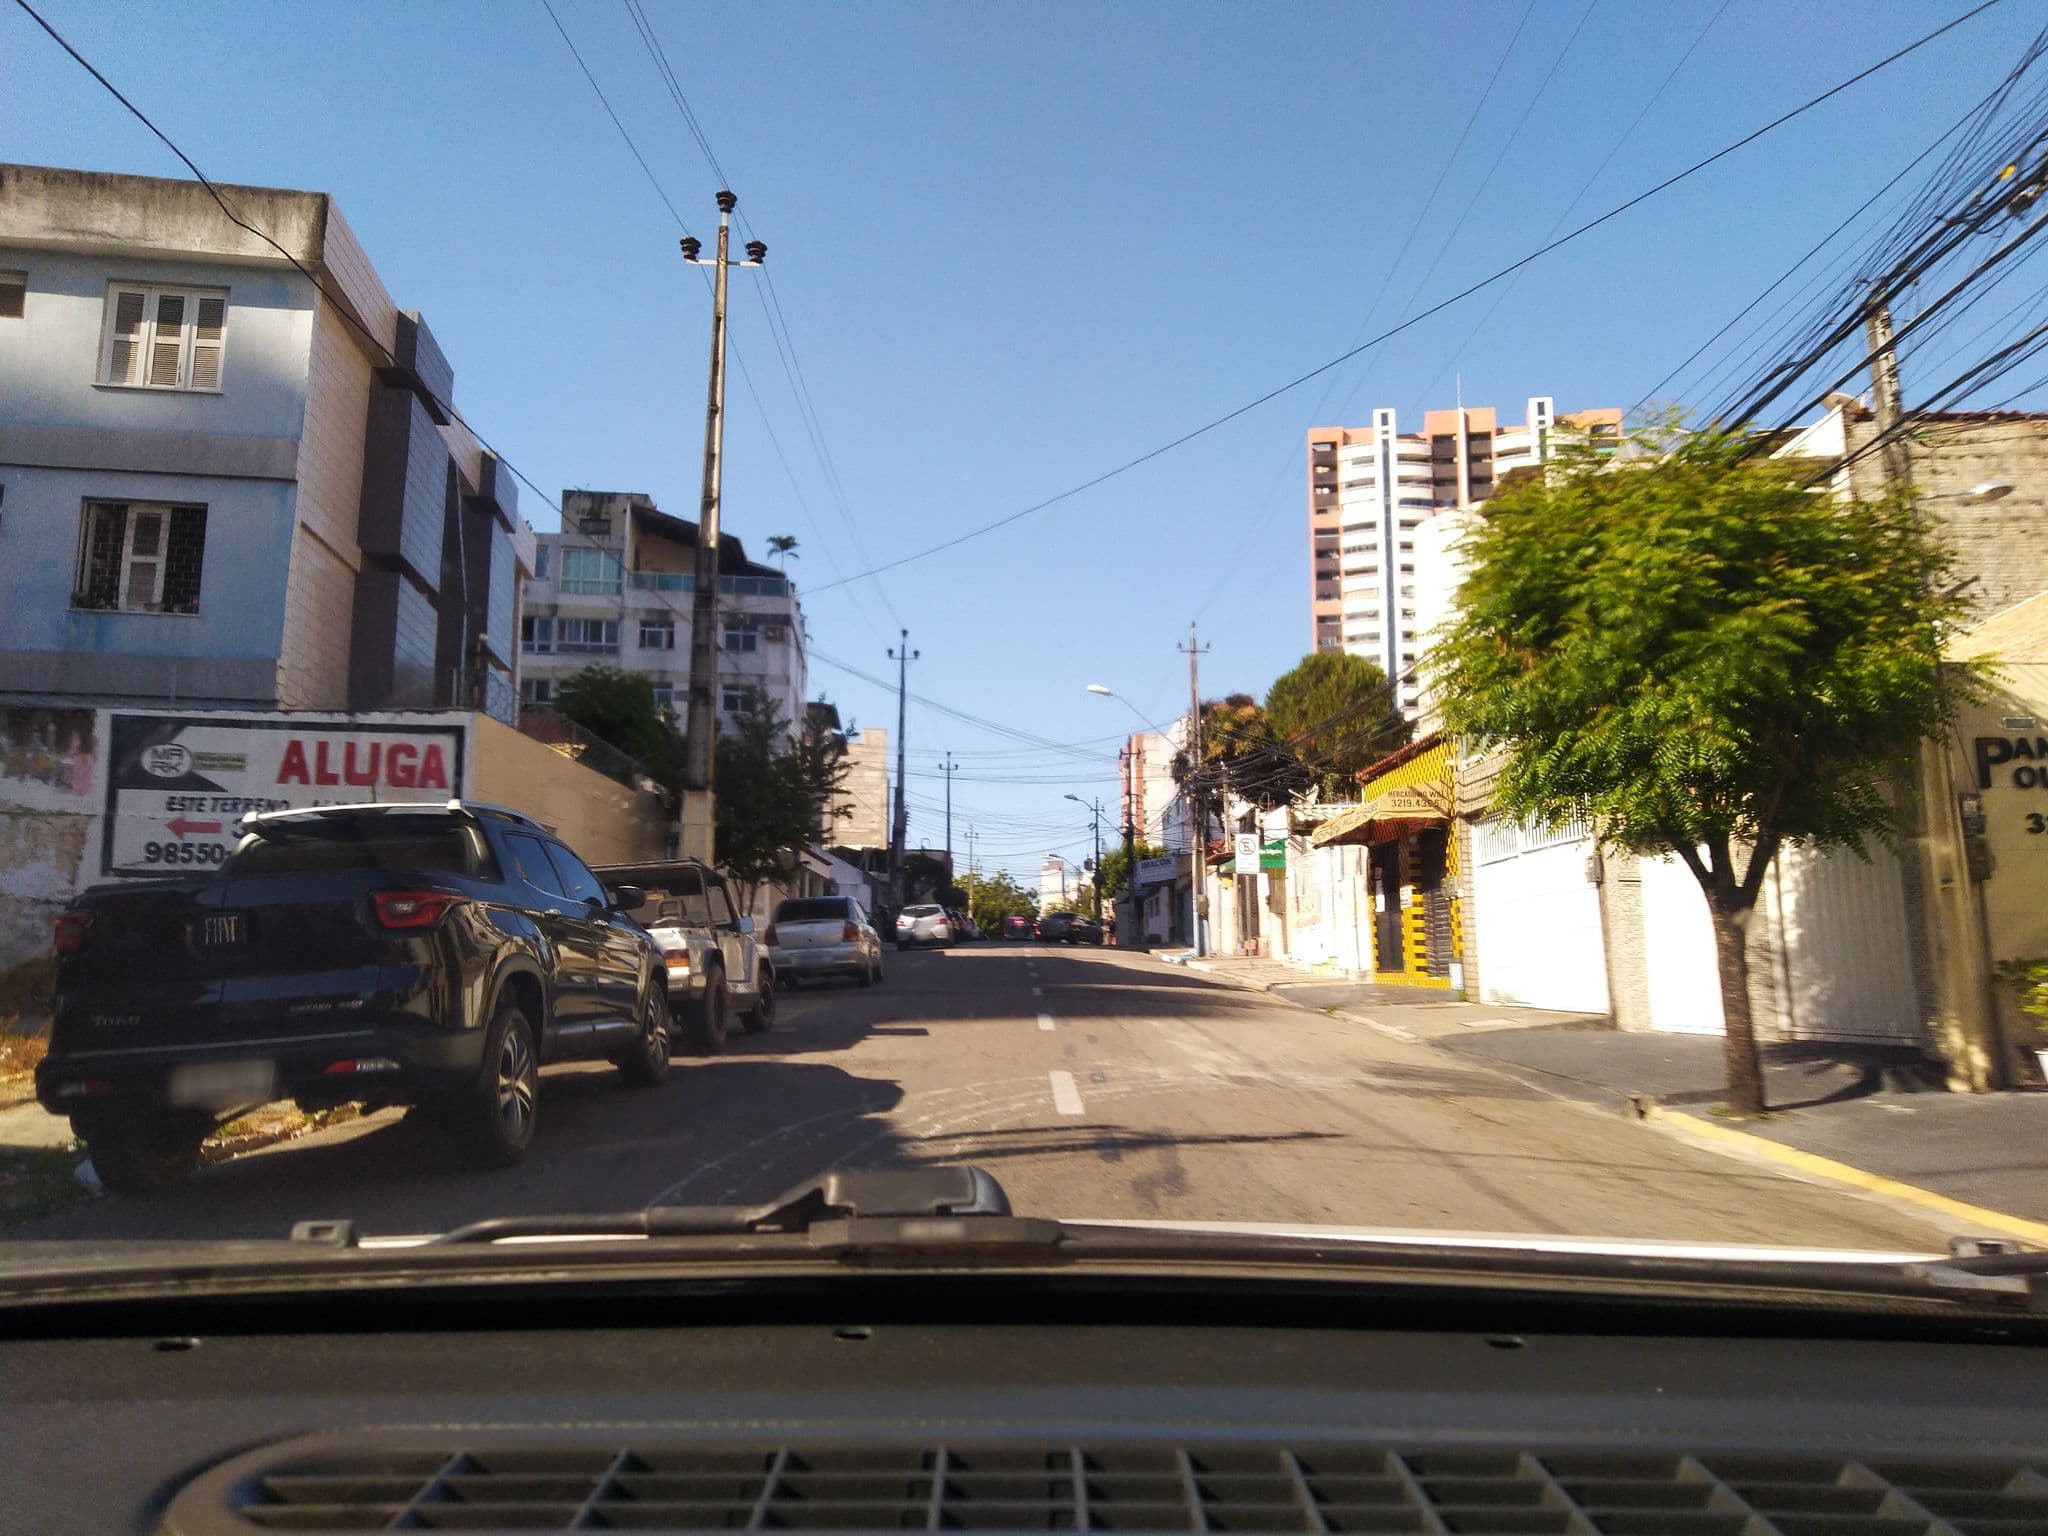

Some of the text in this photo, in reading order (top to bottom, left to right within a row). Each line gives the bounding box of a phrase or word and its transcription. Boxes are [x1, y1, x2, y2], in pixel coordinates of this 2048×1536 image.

[275, 740, 449, 788] ALUGA
[166, 796, 289, 814] ESTE TERRENO
[2025, 812, 2048, 834] 3
[205, 915, 238, 945] FIAT
